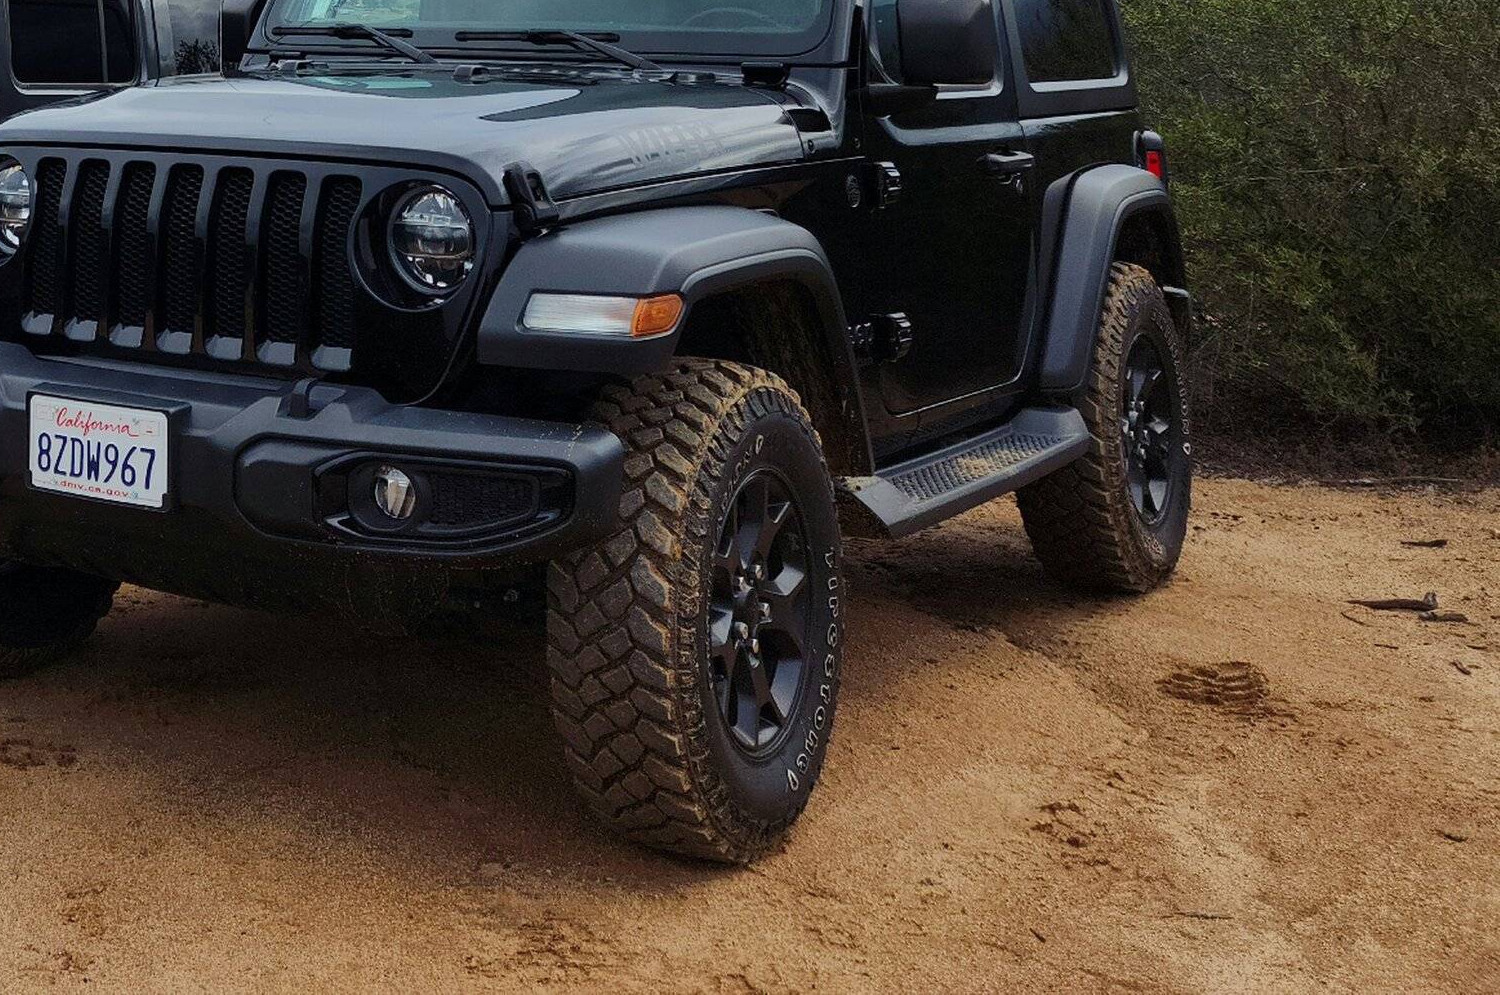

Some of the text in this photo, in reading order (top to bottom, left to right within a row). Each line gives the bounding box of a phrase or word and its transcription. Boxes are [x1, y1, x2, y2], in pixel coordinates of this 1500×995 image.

[56, 406, 139, 438] California
[37, 432, 156, 491] 8ZDW967
[60, 479, 129, 499] dmv.ca.gov
